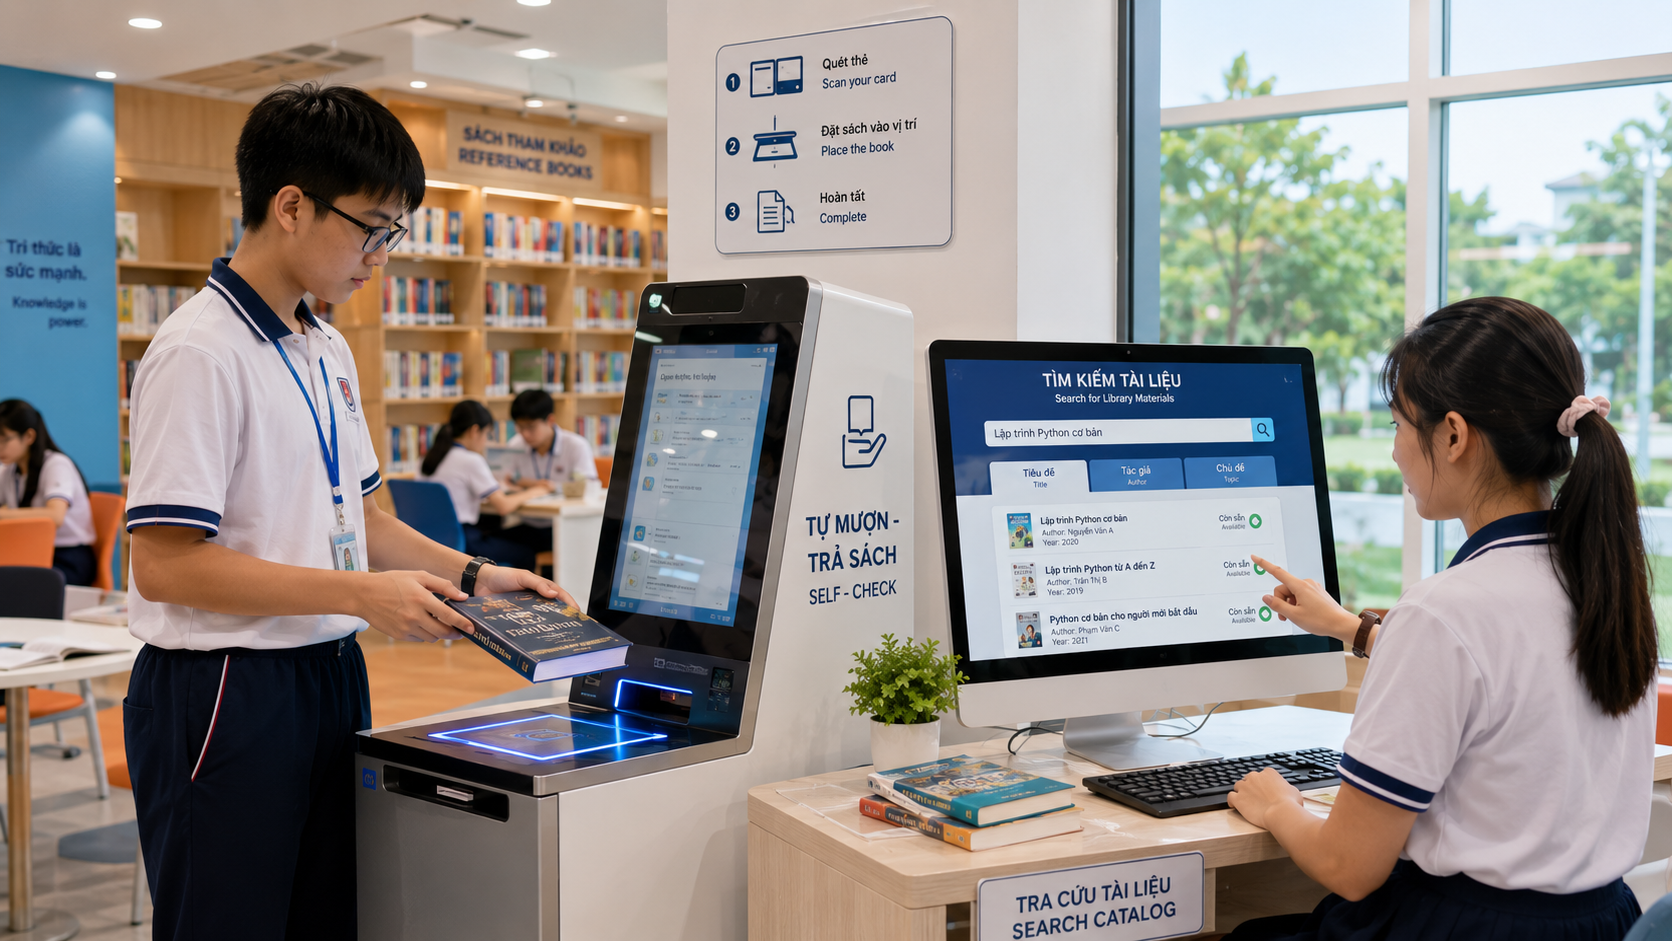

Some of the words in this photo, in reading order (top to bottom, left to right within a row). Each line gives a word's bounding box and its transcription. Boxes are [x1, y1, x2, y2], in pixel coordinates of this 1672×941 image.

[822, 56, 848, 70] Quét
[851, 54, 868, 66] thẻ
[822, 78, 846, 89] Scan
[849, 75, 872, 89] your
[874, 71, 896, 84] card
[821, 124, 840, 138] Đặt
[842, 122, 867, 135] sách
[870, 121, 889, 132] vào
[892, 119, 902, 133] vị
[905, 117, 917, 130] trí
[463, 124, 502, 146] SÁCH
[506, 132, 545, 152] THAM
[821, 144, 848, 156] Place
[850, 142, 867, 154] the
[869, 140, 894, 153] book
[458, 148, 542, 173] REFERENCE
[547, 160, 593, 180] BOOKS
[820, 191, 848, 204] Hoàn
[850, 189, 866, 202] tất
[820, 212, 867, 225] Complete
[12, 296, 75, 312] Knowledge
[78, 298, 87, 310] is
[1042, 369, 1072, 387] TÌM
[1077, 368, 1115, 387] KIẾM
[1119, 370, 1144, 387] TÀI
[1148, 371, 1181, 391] LIỆU
[1055, 394, 1086, 403] Search
[1088, 393, 1100, 403] for
[1103, 393, 1133, 404] Library
[1136, 393, 1174, 403] Materials
[1038, 428, 1069, 439] Python
[806, 513, 831, 540] TỰ
[836, 510, 888, 536] MƯỢN
[1075, 515, 1102, 525] Python
[1062, 538, 1079, 546] 2020
[808, 544, 844, 573] TRẢ
[849, 542, 897, 568] SÁCH
[1084, 564, 1112, 574] Python
[1149, 561, 1155, 570] Z
[809, 586, 841, 605] SELF
[852, 579, 897, 599] CHECK
[1066, 587, 1084, 595] 2019
[1050, 615, 1078, 625] Python
[1110, 612, 1125, 620] cho
[1114, 624, 1120, 632] C
[1016, 893, 1052, 914] TRA
[1058, 885, 1096, 908] CỨU
[1101, 879, 1128, 902] TÀI
[1134, 875, 1171, 899] LIỆU
[1012, 914, 1088, 940] SEARCH
[1093, 901, 1176, 928] CATALOG
